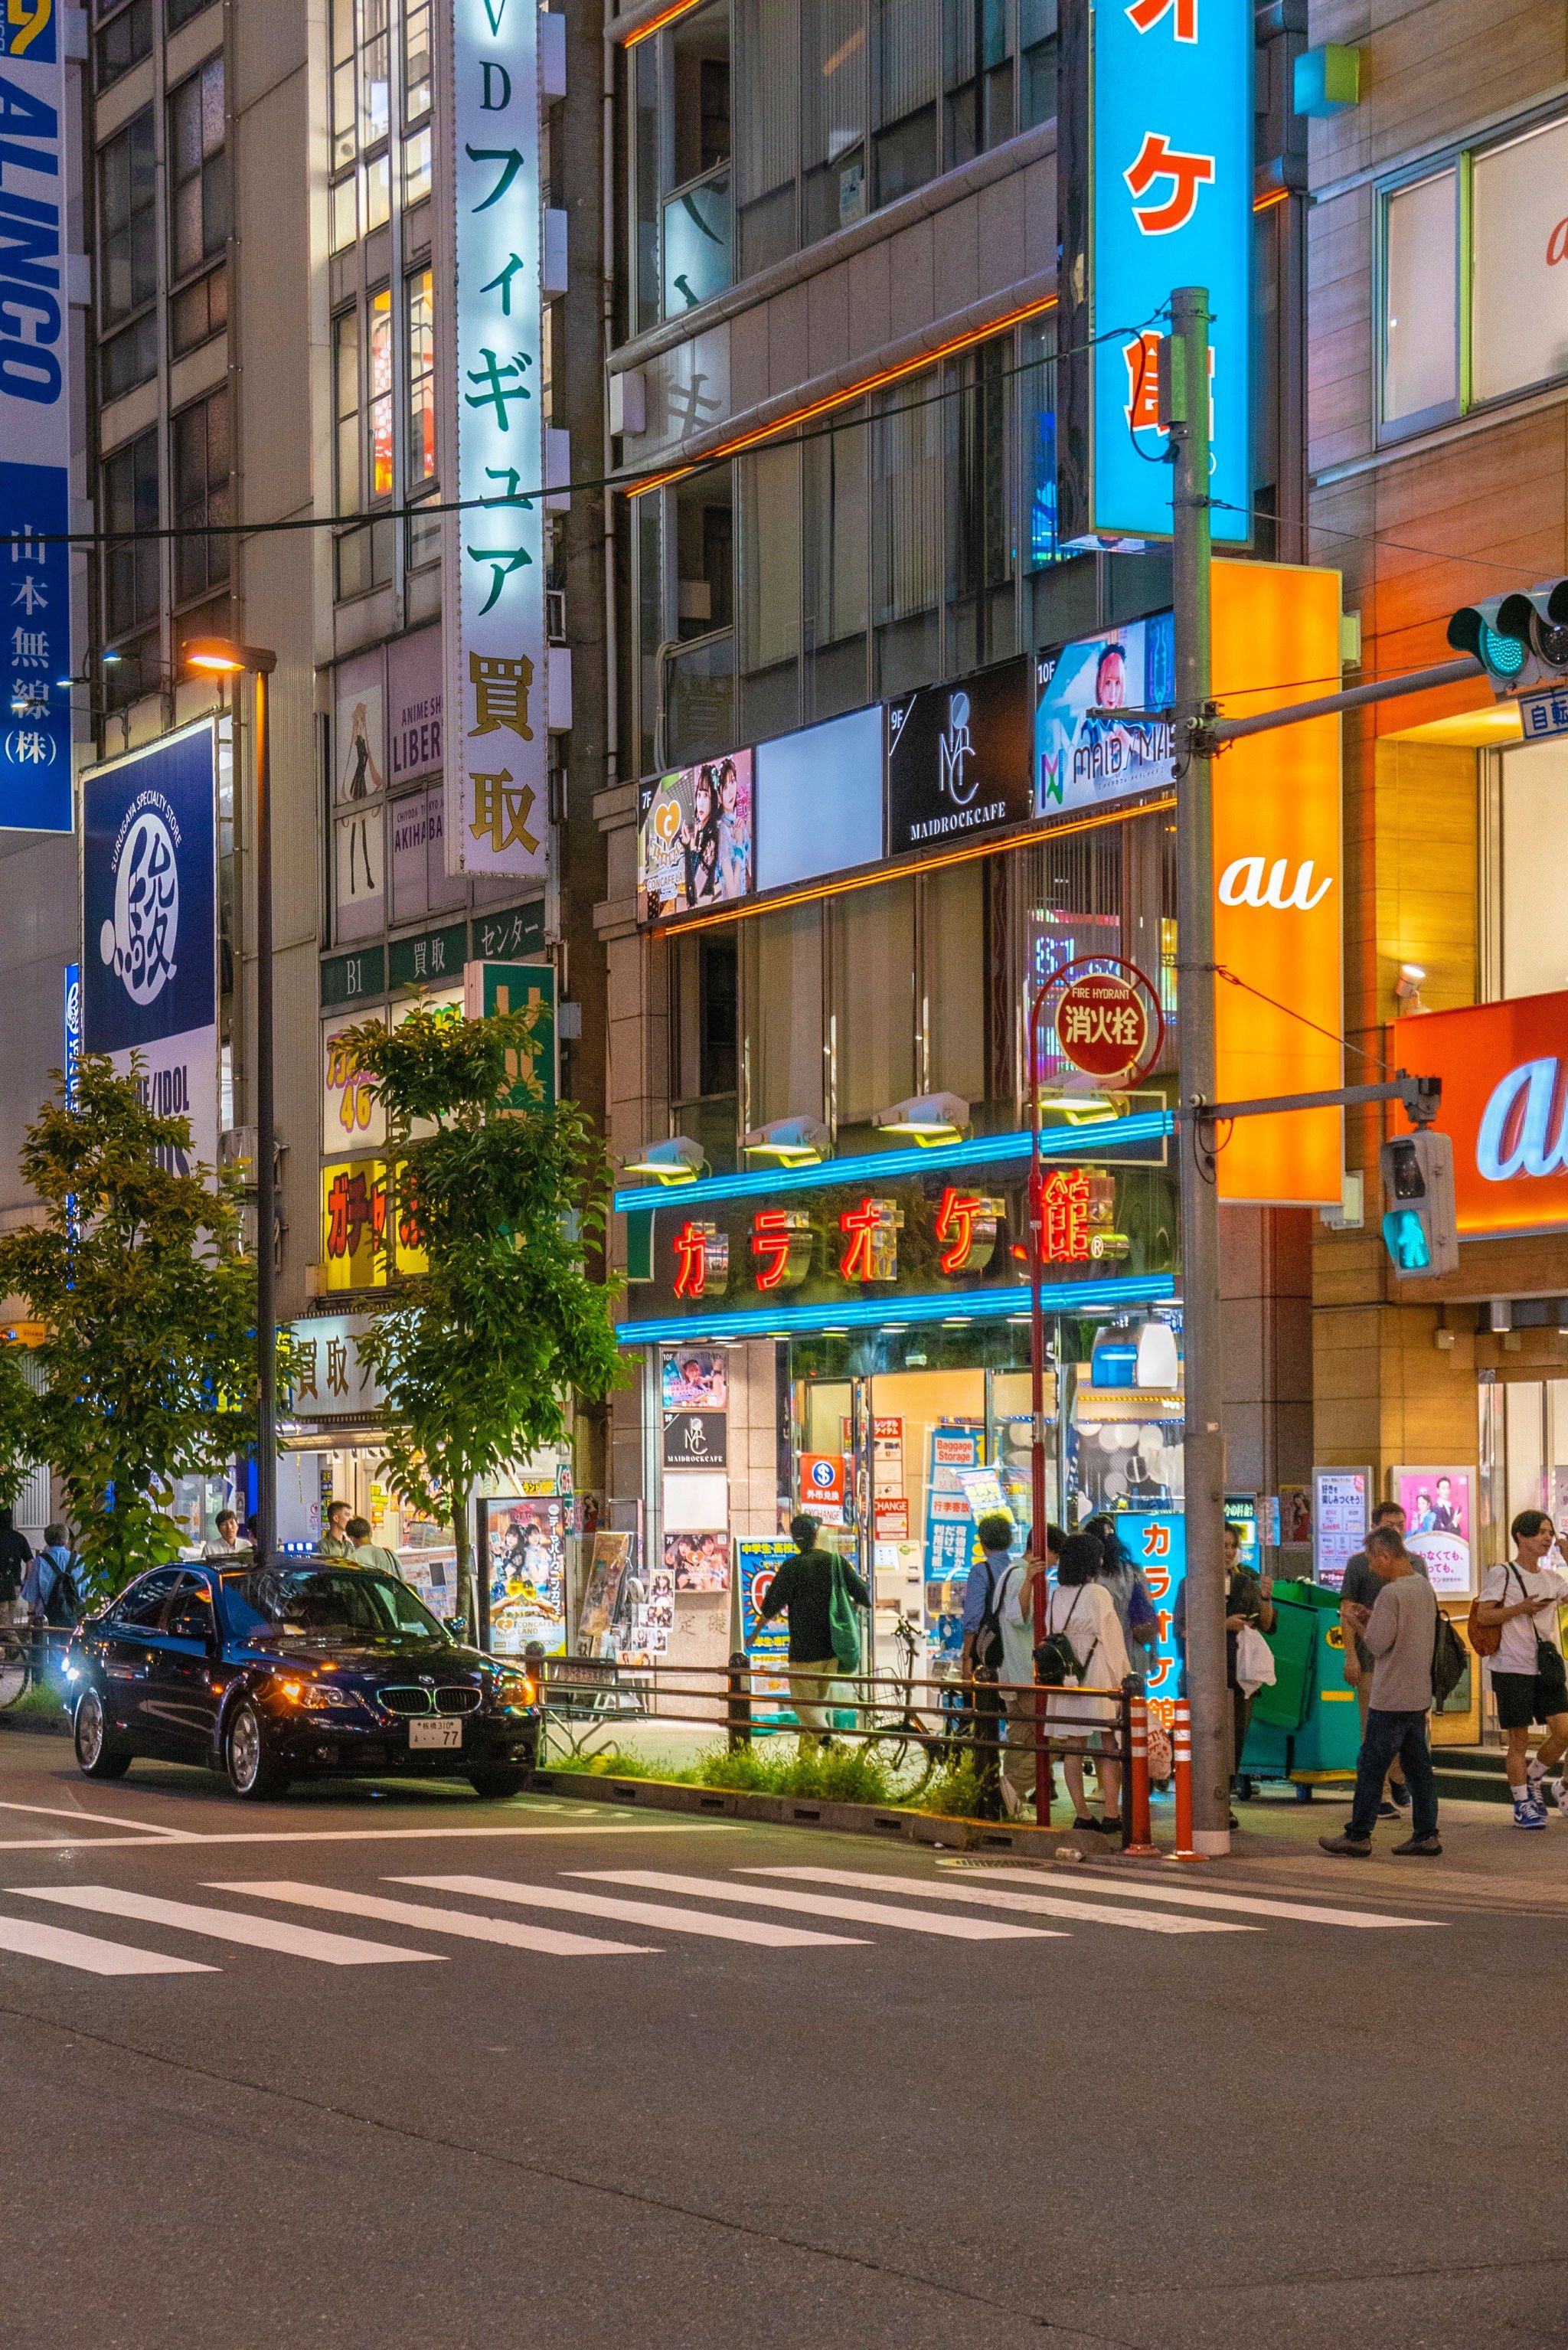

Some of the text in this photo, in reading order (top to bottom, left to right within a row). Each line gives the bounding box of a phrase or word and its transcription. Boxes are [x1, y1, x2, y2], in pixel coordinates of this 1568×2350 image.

[0, 75, 61, 405] ALINCO
[1038, 660, 1055, 685] 10F
[401, 700, 429, 727] ANIME
[891, 709, 903, 730] 9F
[394, 718, 443, 773] LIBER
[468, 651, 541, 855] 買取
[642, 790, 652, 809] 7F
[111, 790, 182, 873] SURUGAYA SPECIALTY STORE
[911, 801, 1005, 841] MAIDROCKCAFE
[1218, 855, 1333, 910] au
[346, 916, 539, 995] B1 買取 センター
[1072, 987, 1130, 1000] FIRE HYDRANT
[1065, 1005, 1139, 1045] 消火栓
[1476, 1056, 1568, 1182] a
[673, 1168, 1089, 1299] カラオケ館
[665, 1414, 673, 1423] 9F
[936, 1440, 972, 1452] Baggage
[939, 1451, 971, 1463] Storage
[806, 1489, 840, 1502] 外币兑换
[933, 1501, 970, 1513] 行李寄放
[438, 1721, 450, 1730] 310
[443, 1731, 459, 1746] 77
